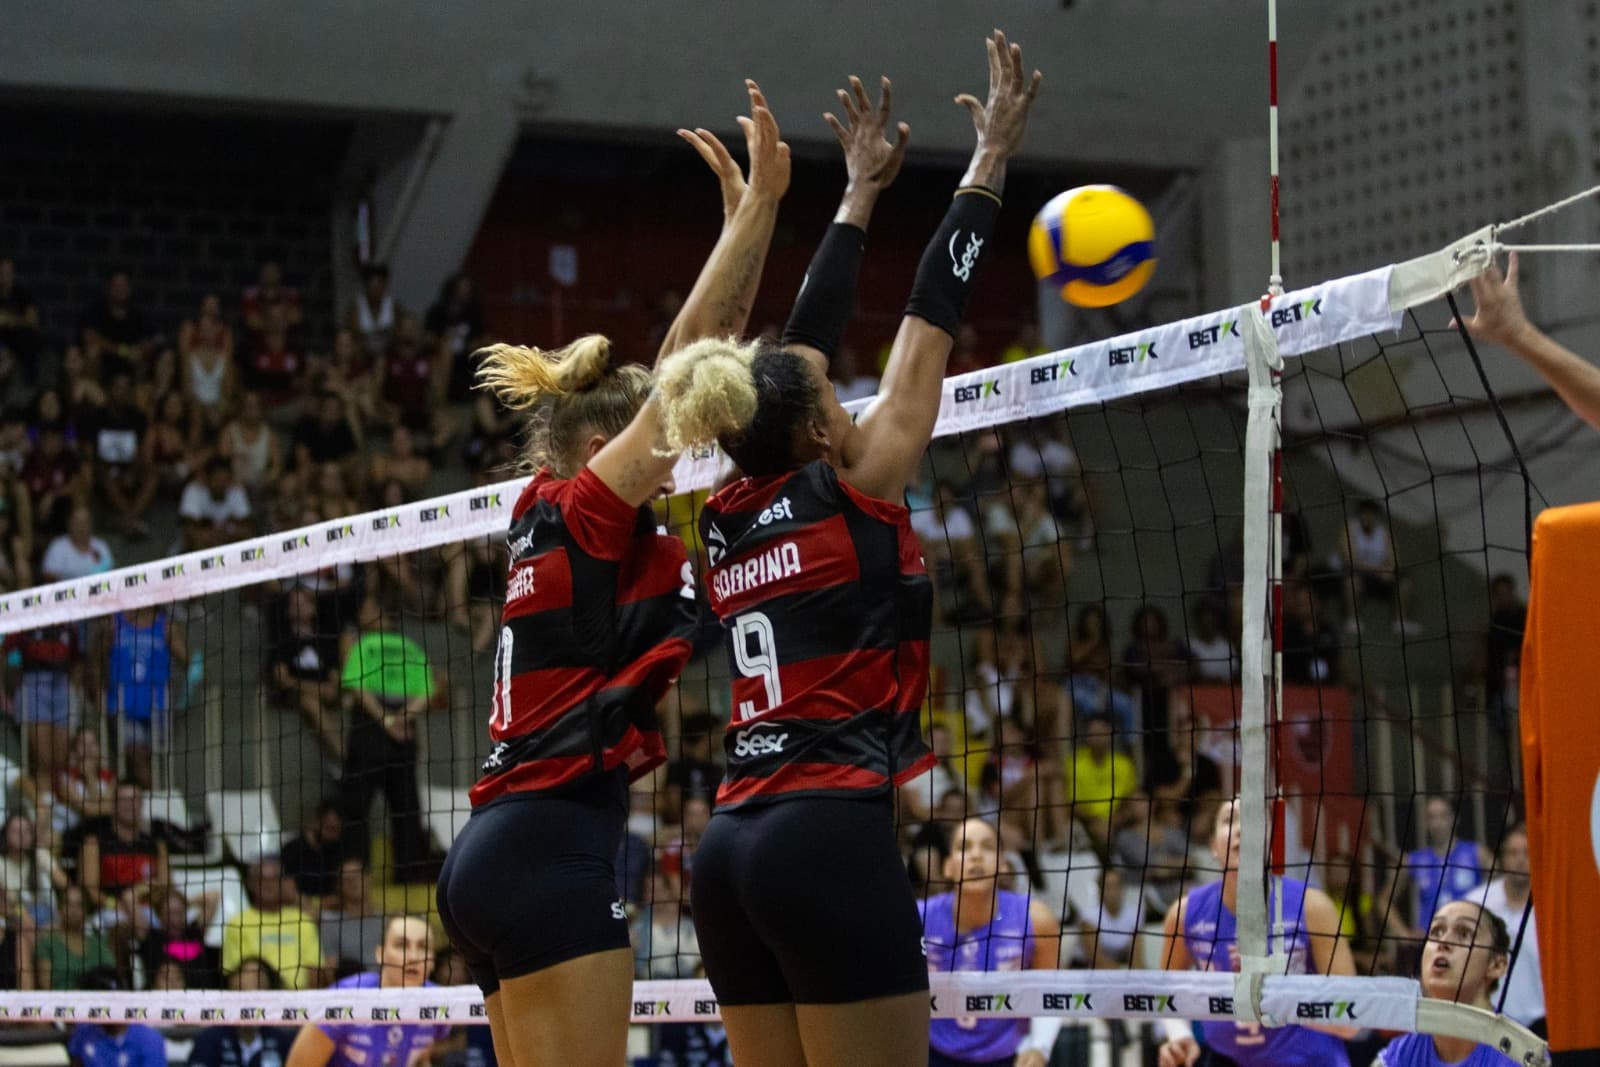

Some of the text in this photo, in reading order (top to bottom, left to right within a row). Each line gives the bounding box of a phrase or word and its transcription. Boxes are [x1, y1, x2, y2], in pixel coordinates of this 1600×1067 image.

[1271, 298, 1322, 329] BET7K
[954, 320, 1240, 404] BET7K BET7K BET7K BET7K
[469, 493, 502, 511] BET7K
[731, 611, 783, 721] 9
[634, 1000, 671, 1015] BET7K
[966, 994, 1013, 1012] BET7K
[1043, 993, 1093, 1011] BET7K
[1123, 994, 1178, 1013] BET7K
[1297, 1001, 1356, 1020] BET7K
[371, 1006, 401, 1021] BET7K
[419, 1005, 450, 1020] BET7K
